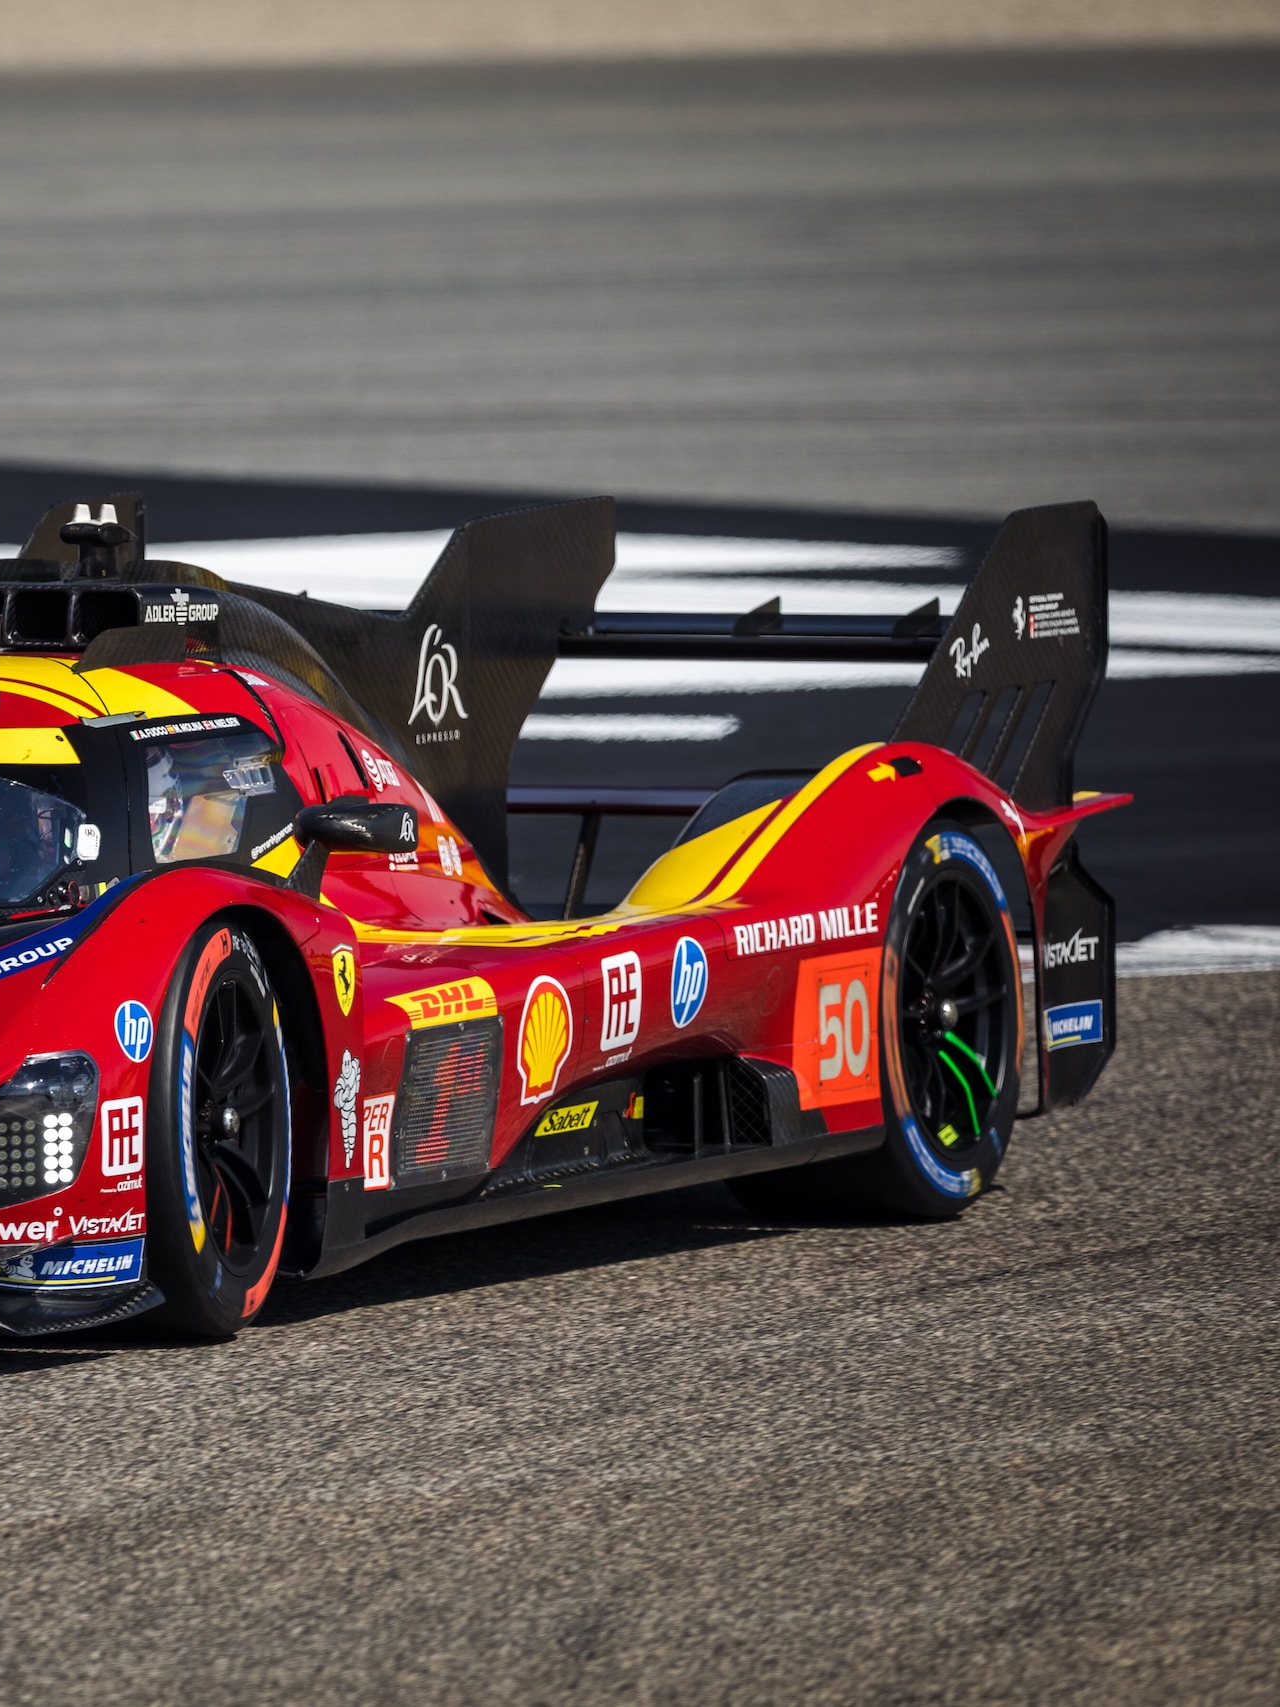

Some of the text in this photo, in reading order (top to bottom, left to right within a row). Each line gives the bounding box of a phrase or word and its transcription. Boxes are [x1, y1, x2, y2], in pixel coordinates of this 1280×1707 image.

[144, 602, 219, 624] ADLER GROUP
[139, 726, 168, 740] A.FUOCO
[734, 902, 878, 956] RICHARD MILLE
[409, 983, 485, 1019] DHL
[819, 978, 870, 1081] 50
[544, 1107, 590, 1132] Sabelt
[117, 1175, 143, 1192] azimut
[40, 1254, 134, 1276] MICHELIN
